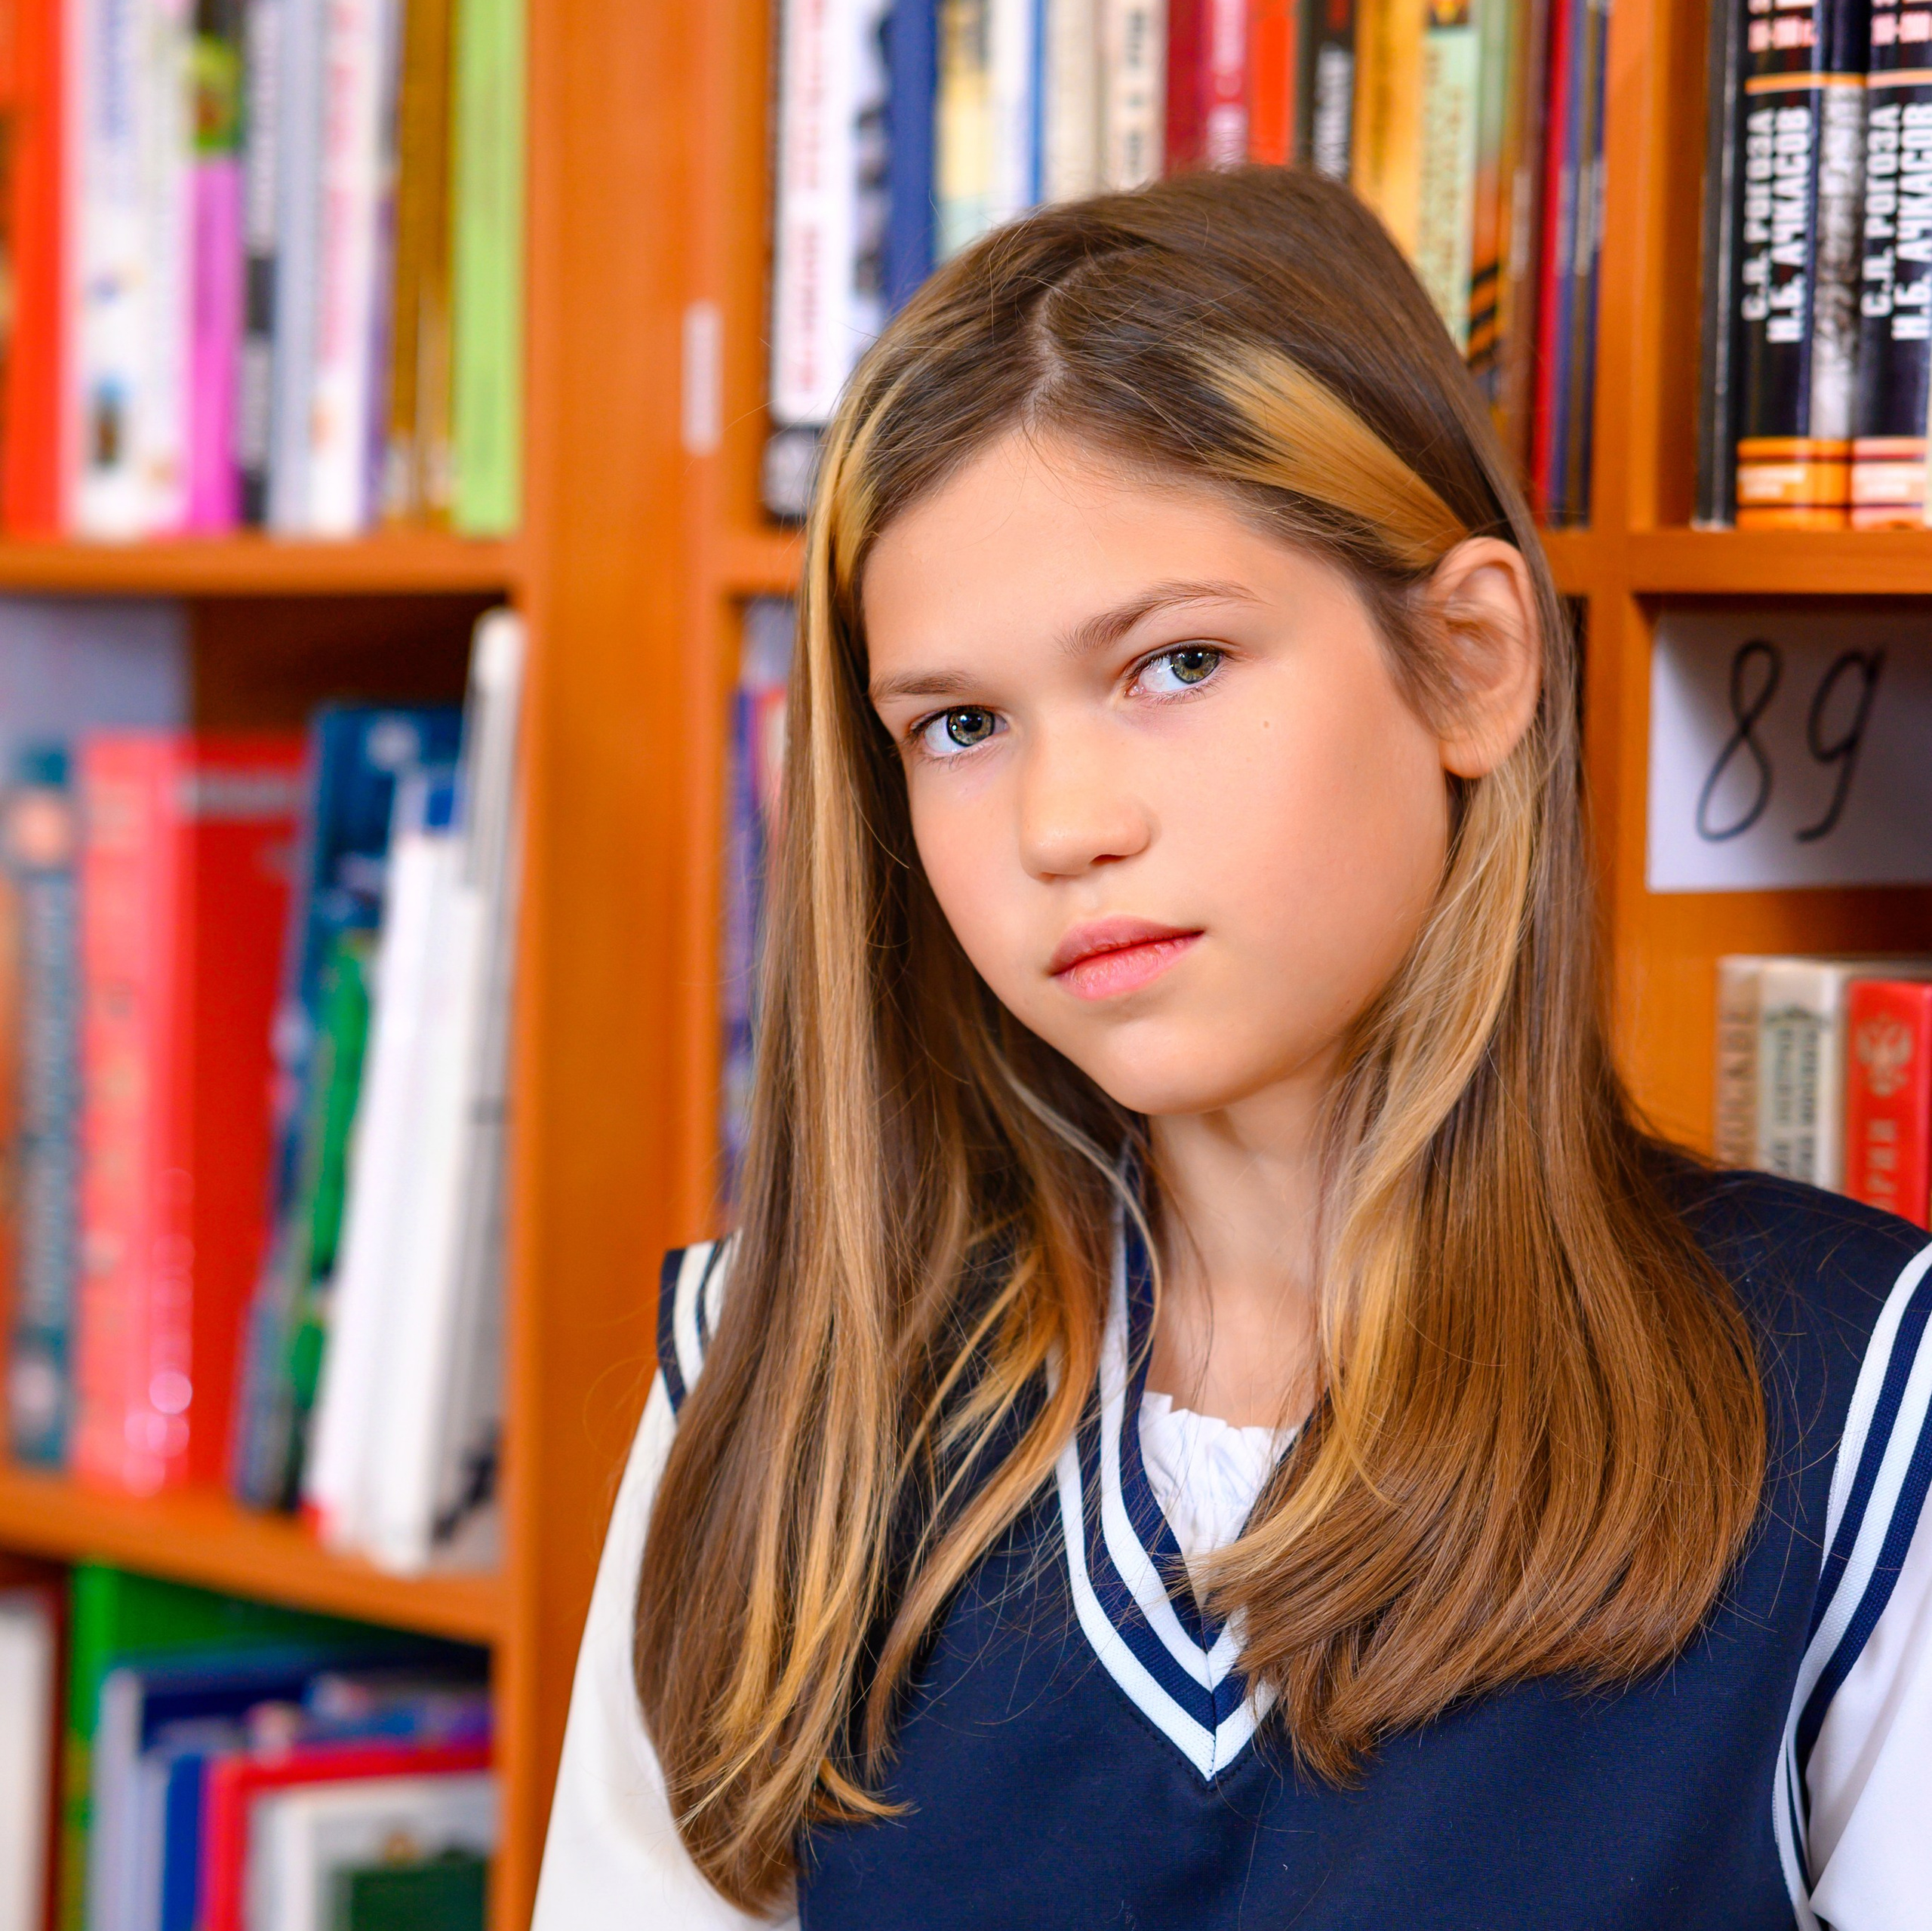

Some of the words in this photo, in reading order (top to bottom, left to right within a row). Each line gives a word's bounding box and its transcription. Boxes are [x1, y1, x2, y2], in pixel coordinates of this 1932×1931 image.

[1743, 107, 1774, 244] РОГОЗА
[1771, 106, 1810, 266] АЧКАСОВ
[1864, 103, 1902, 239] РОГОЗА
[1896, 102, 1932, 263] АЧКАСОВ
[1860, 245, 1896, 318] С.Л.
[1696, 640, 1886, 844] 89
